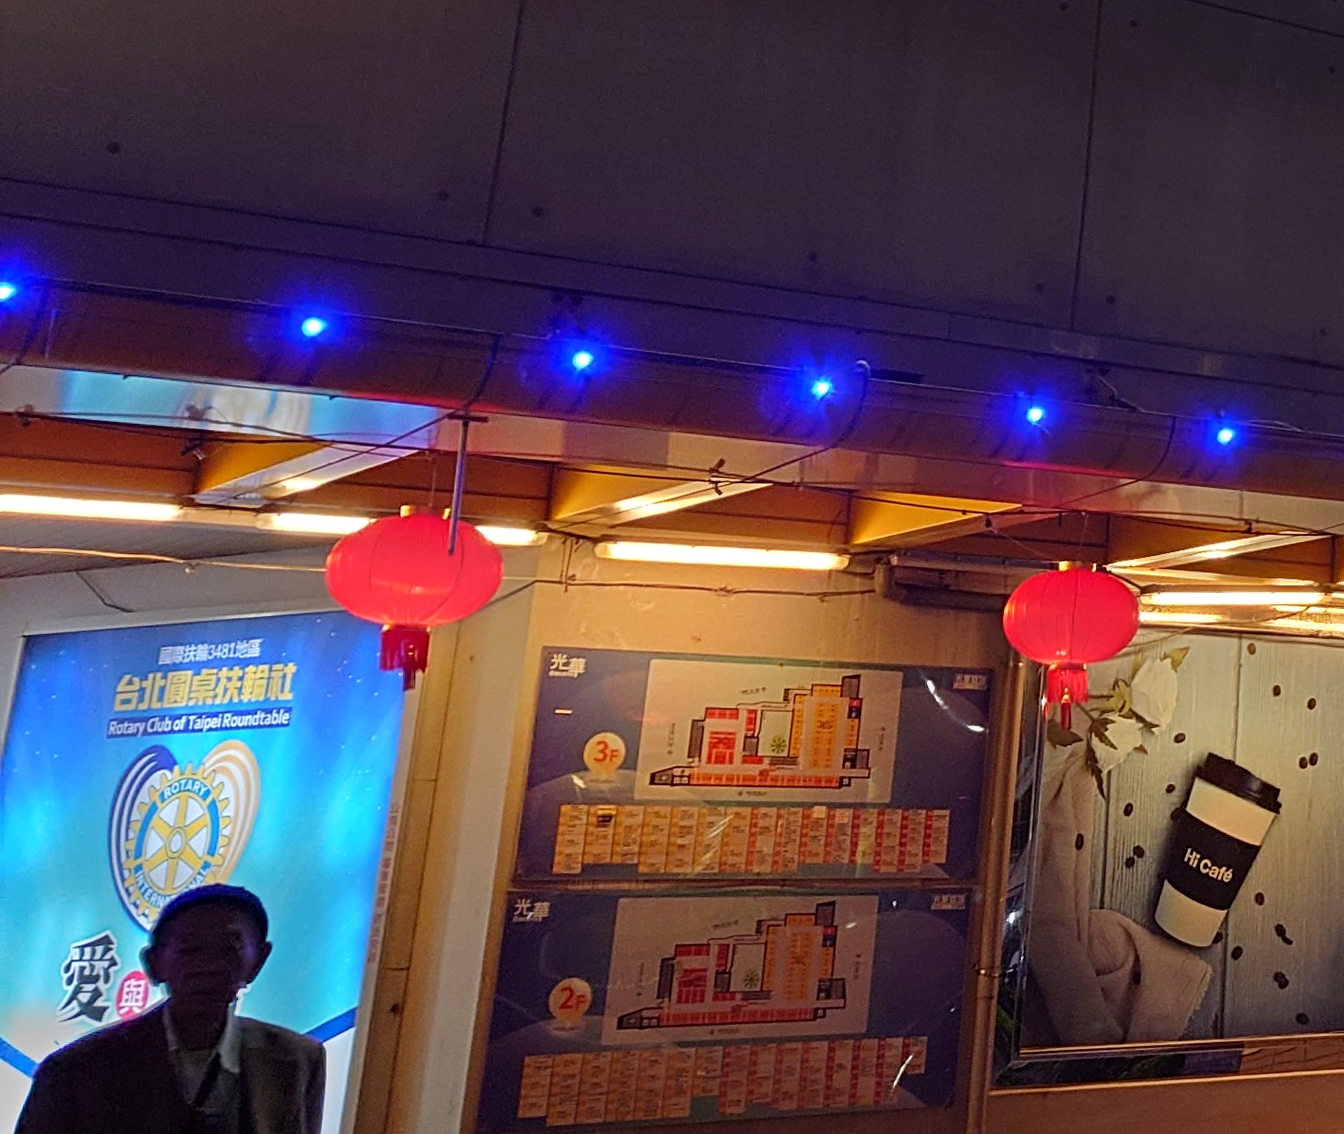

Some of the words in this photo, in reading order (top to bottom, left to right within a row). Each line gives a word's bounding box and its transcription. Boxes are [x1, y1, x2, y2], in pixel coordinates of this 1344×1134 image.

[113, 662, 297, 712] 台北圓桌扶輪社
[108, 720, 145, 738] Rotary
[147, 717, 171, 733] Club
[173, 717, 185, 731] of
[188, 714, 222, 732] Taipei
[223, 708, 290, 727] Roundtable
[593, 739, 620, 764] 3F
[163, 780, 208, 800] ROTARY
[1183, 847, 1201, 868] Hi
[1199, 858, 1233, 883] Café
[559, 986, 587, 1012] 2F
